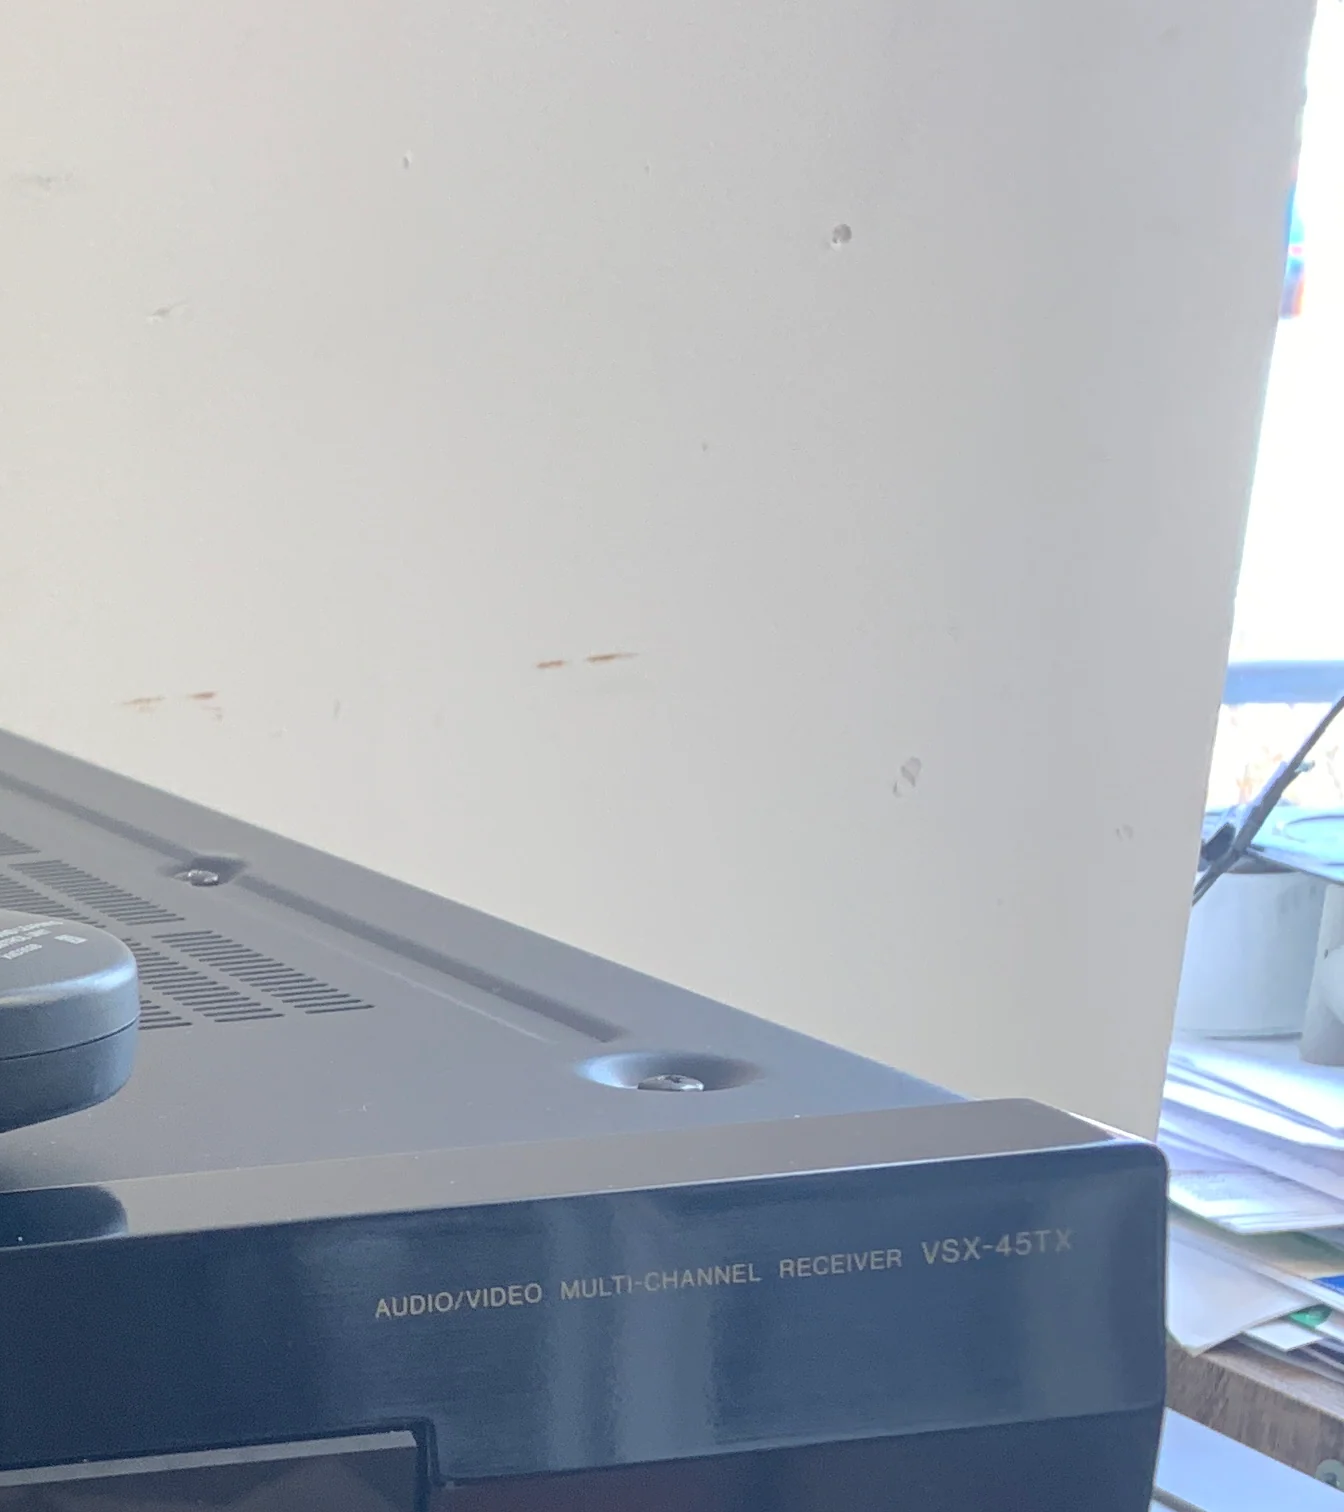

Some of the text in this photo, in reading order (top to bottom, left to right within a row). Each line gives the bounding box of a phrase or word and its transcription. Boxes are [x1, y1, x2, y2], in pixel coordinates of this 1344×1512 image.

[374, 1227, 1074, 1319] AUDIO/VIDEO MULTI-CHANNEL RECEIVER VSX-45TX
